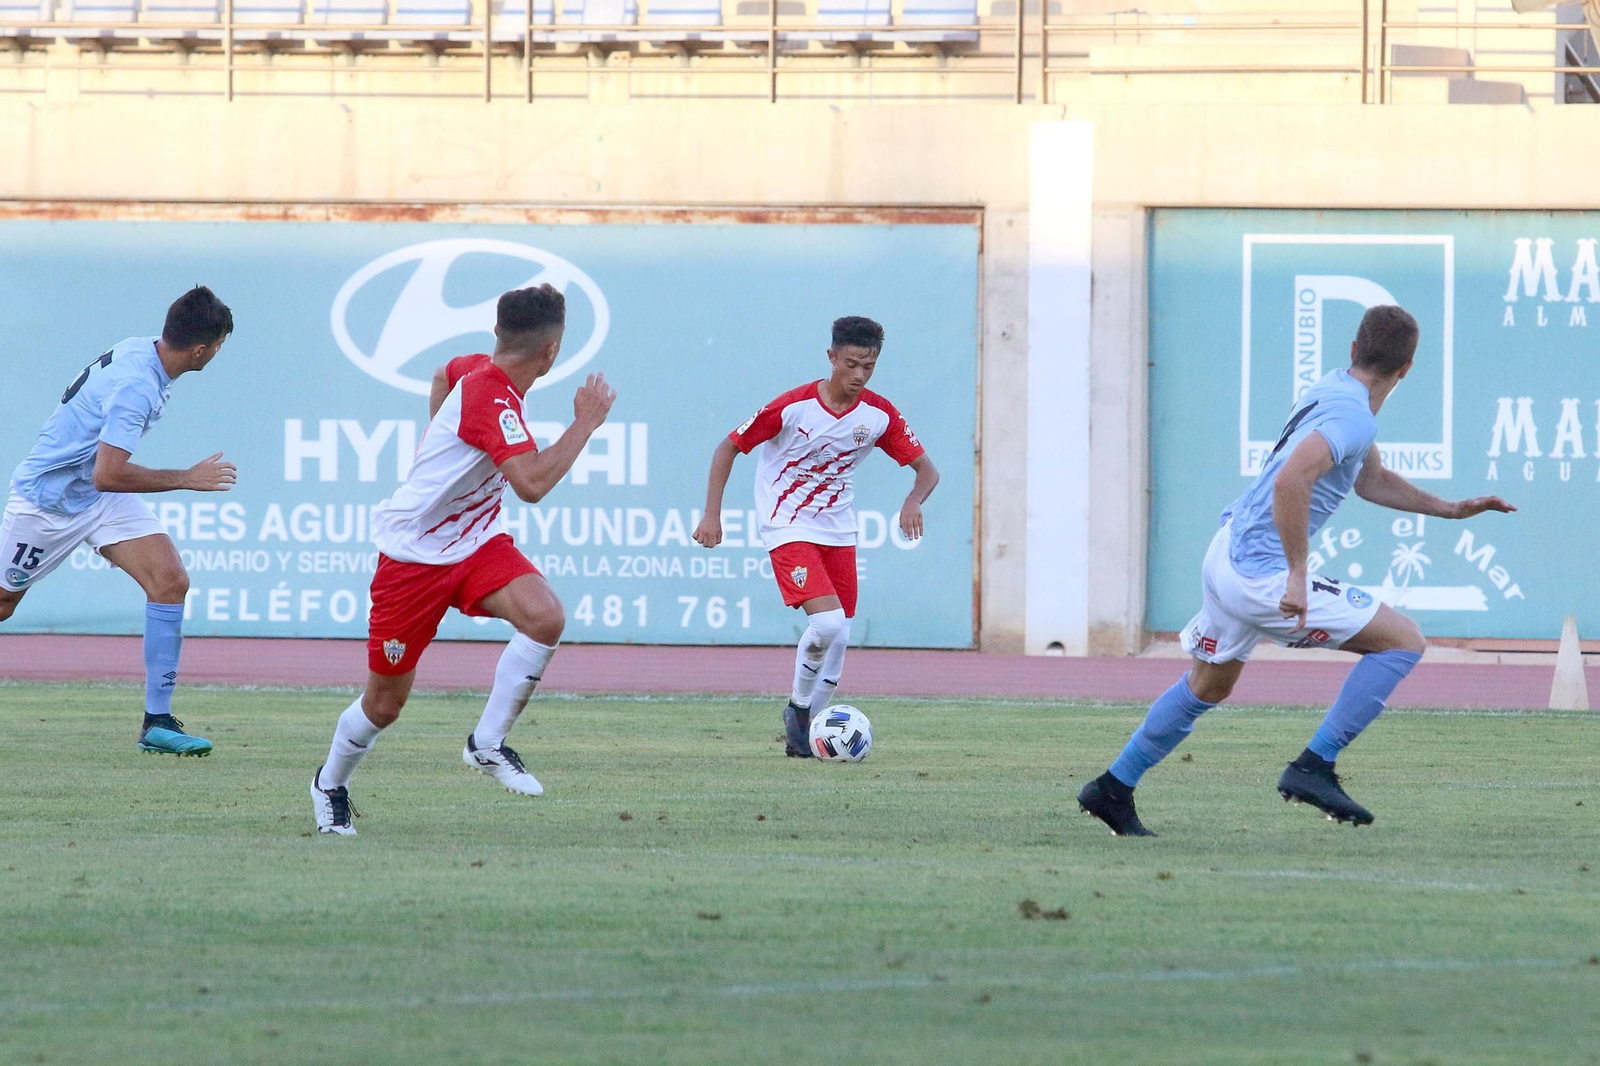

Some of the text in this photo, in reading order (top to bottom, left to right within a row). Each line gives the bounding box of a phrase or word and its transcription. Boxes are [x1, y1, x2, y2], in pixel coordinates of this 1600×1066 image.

[1487, 397, 1600, 458] MA
[284, 418, 648, 486] HYAI
[1380, 450, 1444, 471] RINKS
[1486, 461, 1600, 482] AGU
[258, 503, 379, 542] AGUI
[12, 542, 44, 570] 15
[277, 550, 292, 573] Y
[298, 551, 379, 573] SERVIC
[529, 554, 578, 576] ARA
[583, 555, 612, 577] LA
[617, 555, 685, 578] ZONA
[690, 557, 736, 579] DEL
[1307, 527, 1364, 573] afe
[1454, 529, 1525, 600] Mar
[183, 581, 751, 629] TELÉFO 481 761
